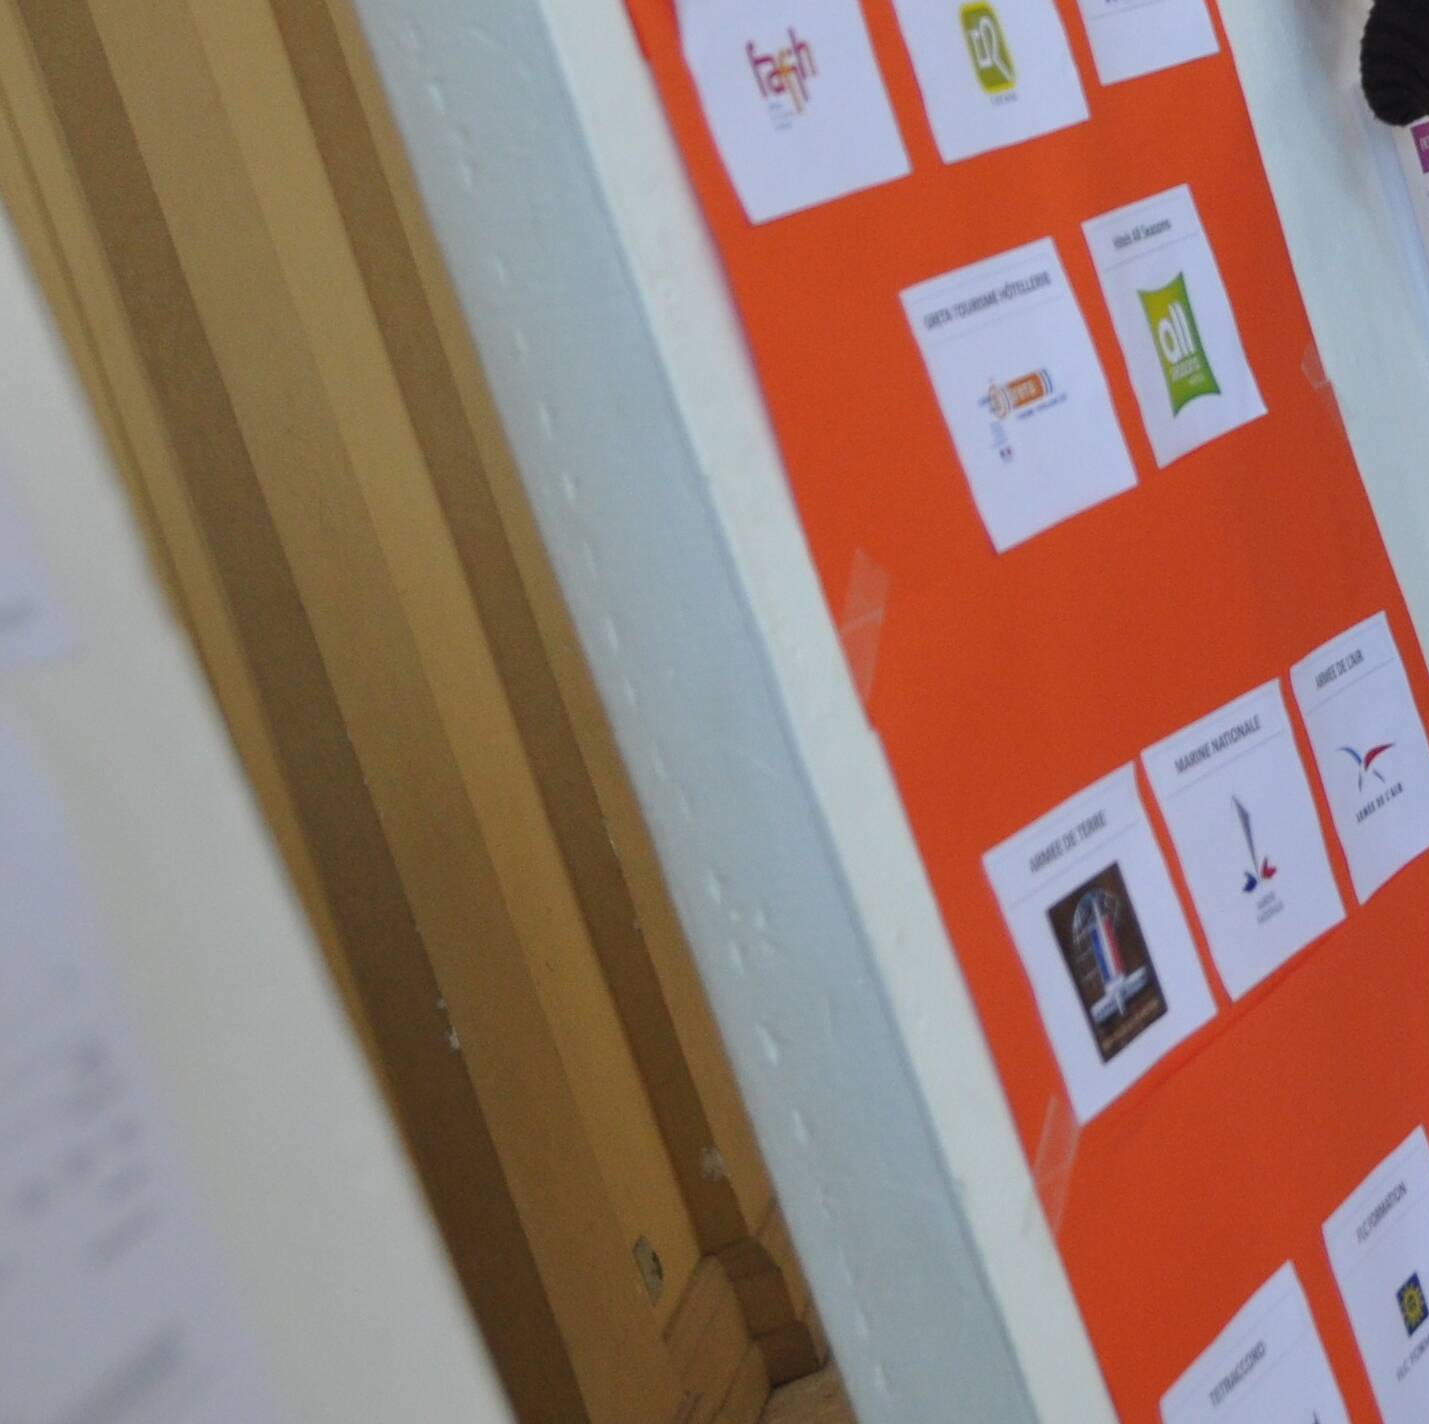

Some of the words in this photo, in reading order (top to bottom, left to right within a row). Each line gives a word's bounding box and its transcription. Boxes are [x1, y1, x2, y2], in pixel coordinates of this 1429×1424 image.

[952, 289, 1000, 320] TOURISME
[1158, 299, 1198, 366] all
[1174, 745, 1212, 775] MARINE
[1209, 714, 1262, 756] NATIONALE
[1062, 830, 1078, 851] DE
[1075, 809, 1107, 844] TERRE
[1368, 1180, 1408, 1228] FORMATION
